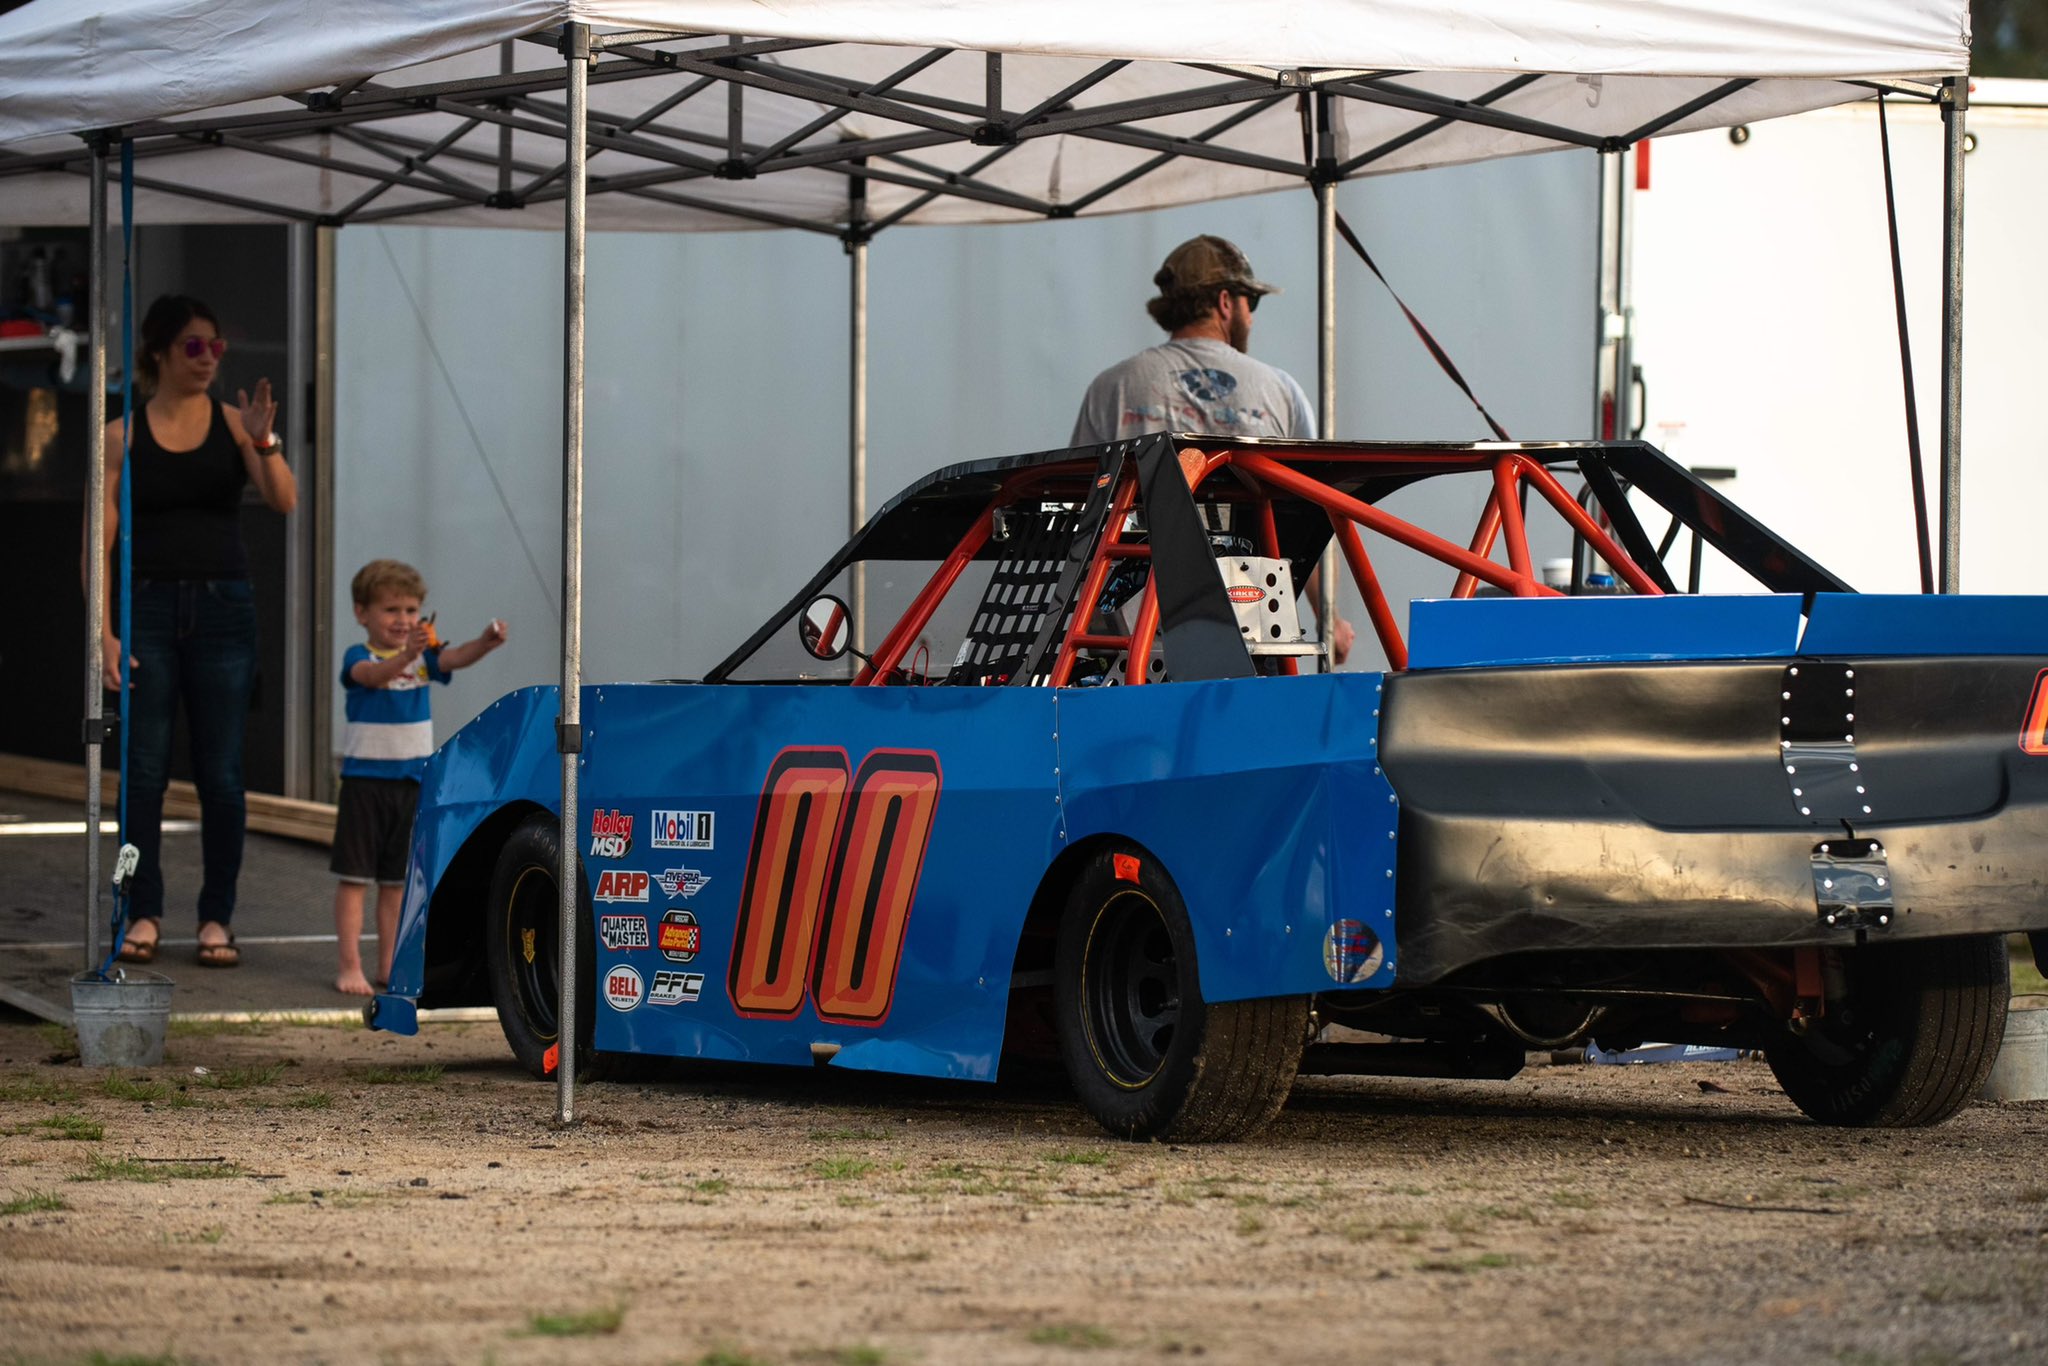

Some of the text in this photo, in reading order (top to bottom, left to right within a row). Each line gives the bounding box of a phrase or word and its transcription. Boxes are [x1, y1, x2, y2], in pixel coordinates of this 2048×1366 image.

[591, 809, 634, 841] Holley
[654, 812, 694, 841] Mobil
[590, 836, 627, 857] MSD
[597, 872, 649, 897] ARP
[725, 745, 943, 1028] 00
[601, 917, 646, 937] QUARTER
[608, 931, 648, 947] MASTER
[609, 976, 637, 997] BELL
[652, 972, 703, 994] PFC
